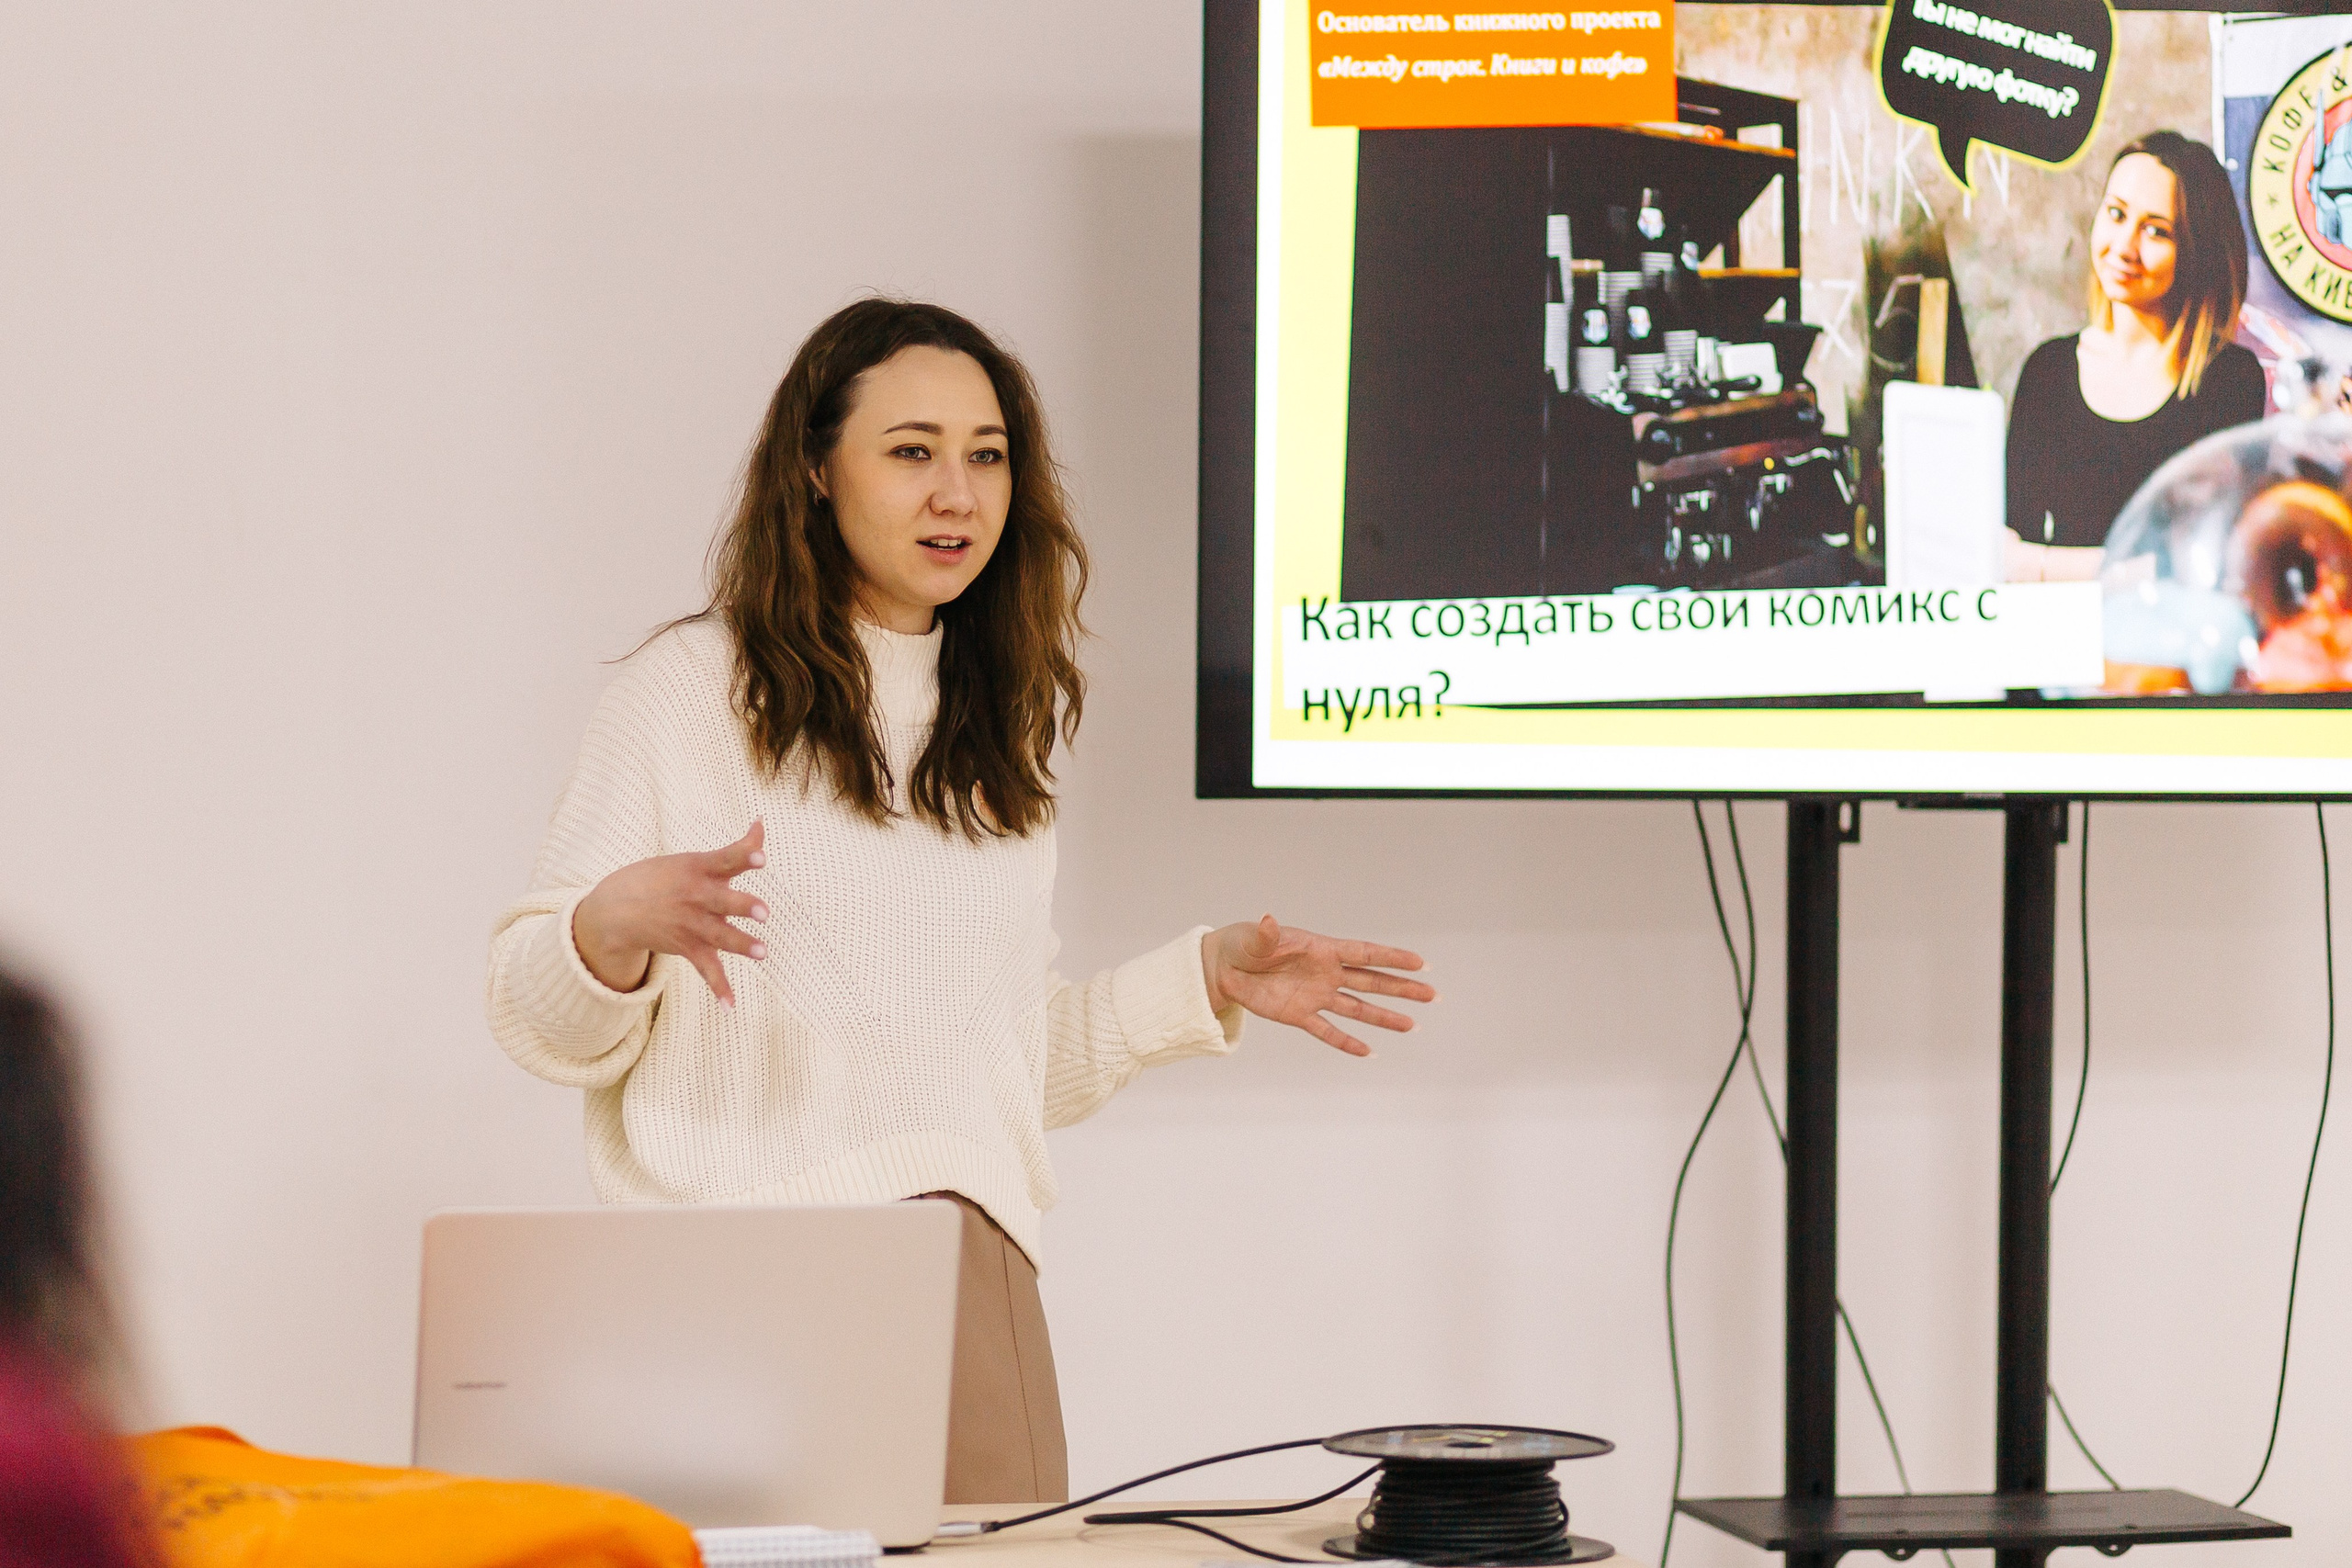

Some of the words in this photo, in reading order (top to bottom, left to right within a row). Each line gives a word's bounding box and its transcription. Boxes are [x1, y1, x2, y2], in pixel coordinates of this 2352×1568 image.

[1317, 10, 1451, 33] Основатель
[1453, 13, 1566, 31] книжного
[1570, 11, 1661, 35] проекта
[1945, 6, 1979, 35] не
[1976, 16, 2026, 49] мог
[2023, 30, 2098, 72] найти
[1317, 54, 1408, 83] «Между
[1411, 59, 1487, 83] строк.
[1490, 52, 1556, 76] Книги
[1561, 58, 1576, 75] и
[1580, 51, 1648, 80] кофе»
[1902, 46, 1994, 91] другую
[1993, 68, 2080, 118] фотку?
[2269, 223, 2303, 269] НА
[1302, 597, 1393, 640] Как
[1411, 598, 1614, 647] создать
[1770, 590, 1959, 626] комикс
[1978, 589, 1997, 621] с
[1303, 670, 1451, 733] нуля?
